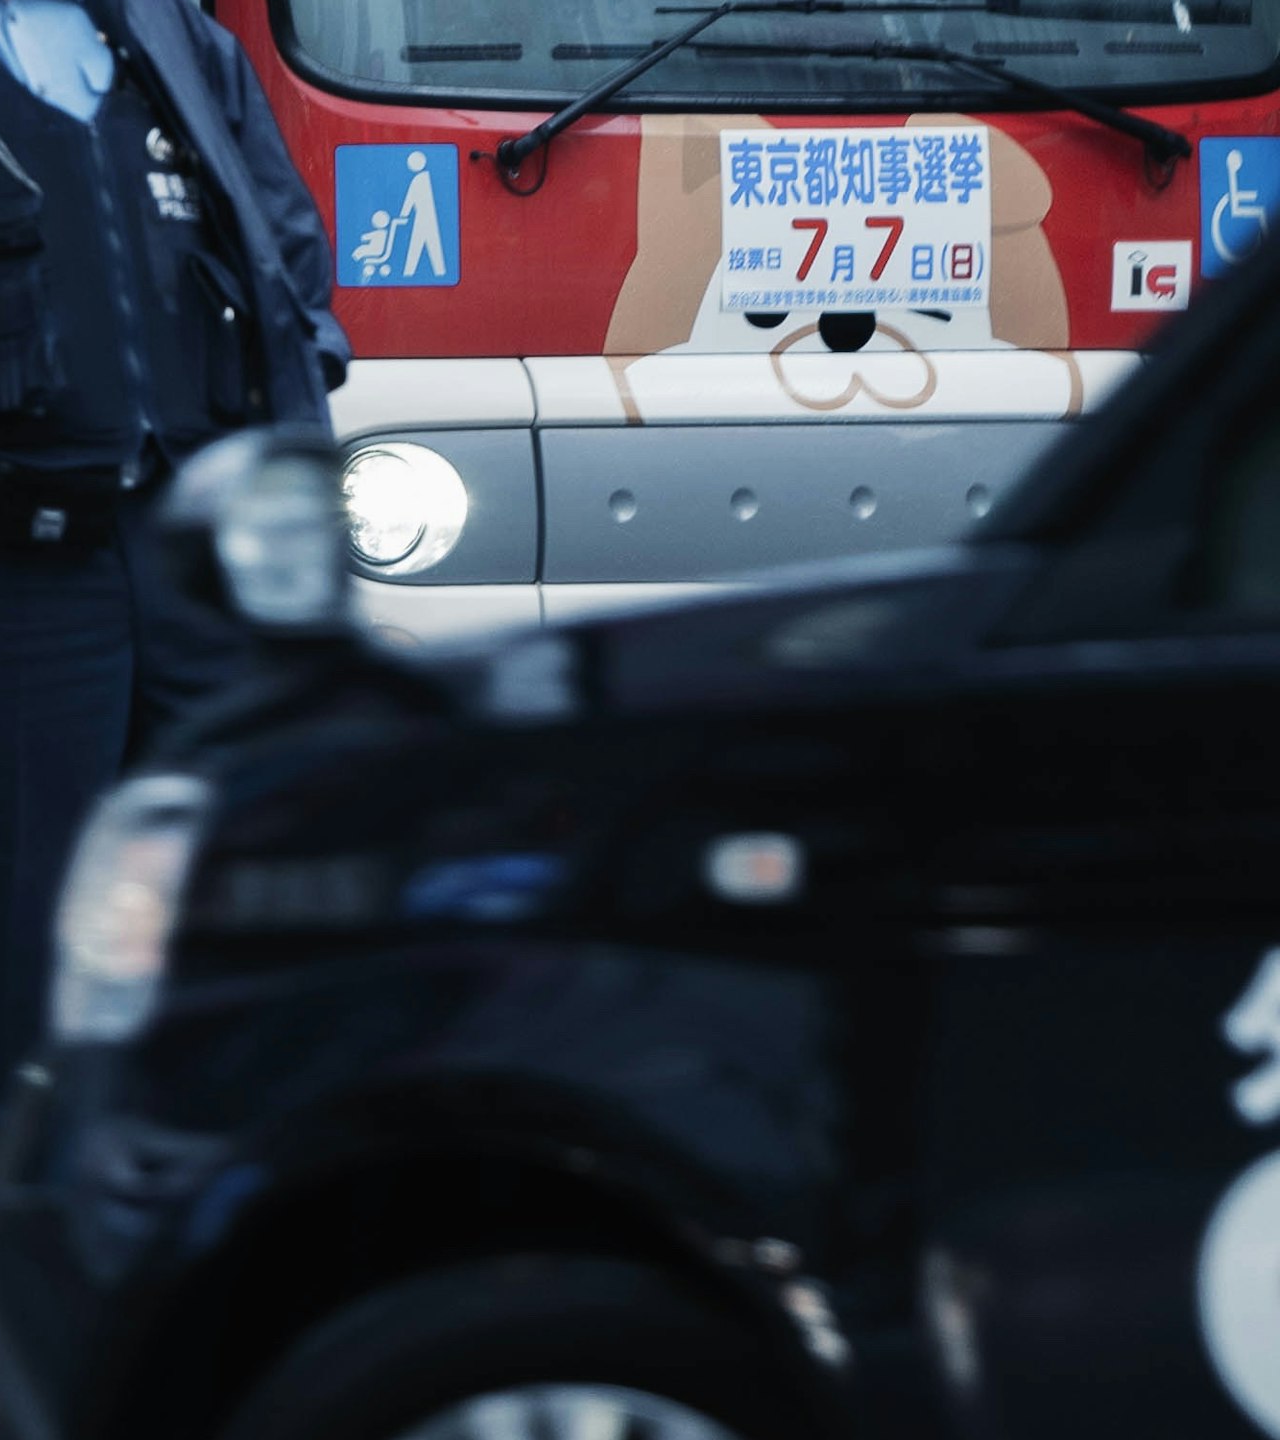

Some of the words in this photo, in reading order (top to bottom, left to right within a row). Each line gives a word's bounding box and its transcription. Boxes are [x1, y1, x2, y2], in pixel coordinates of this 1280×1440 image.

[727, 133, 984, 207] 東京都知事選挙
[727, 246, 782, 271] 投票日
